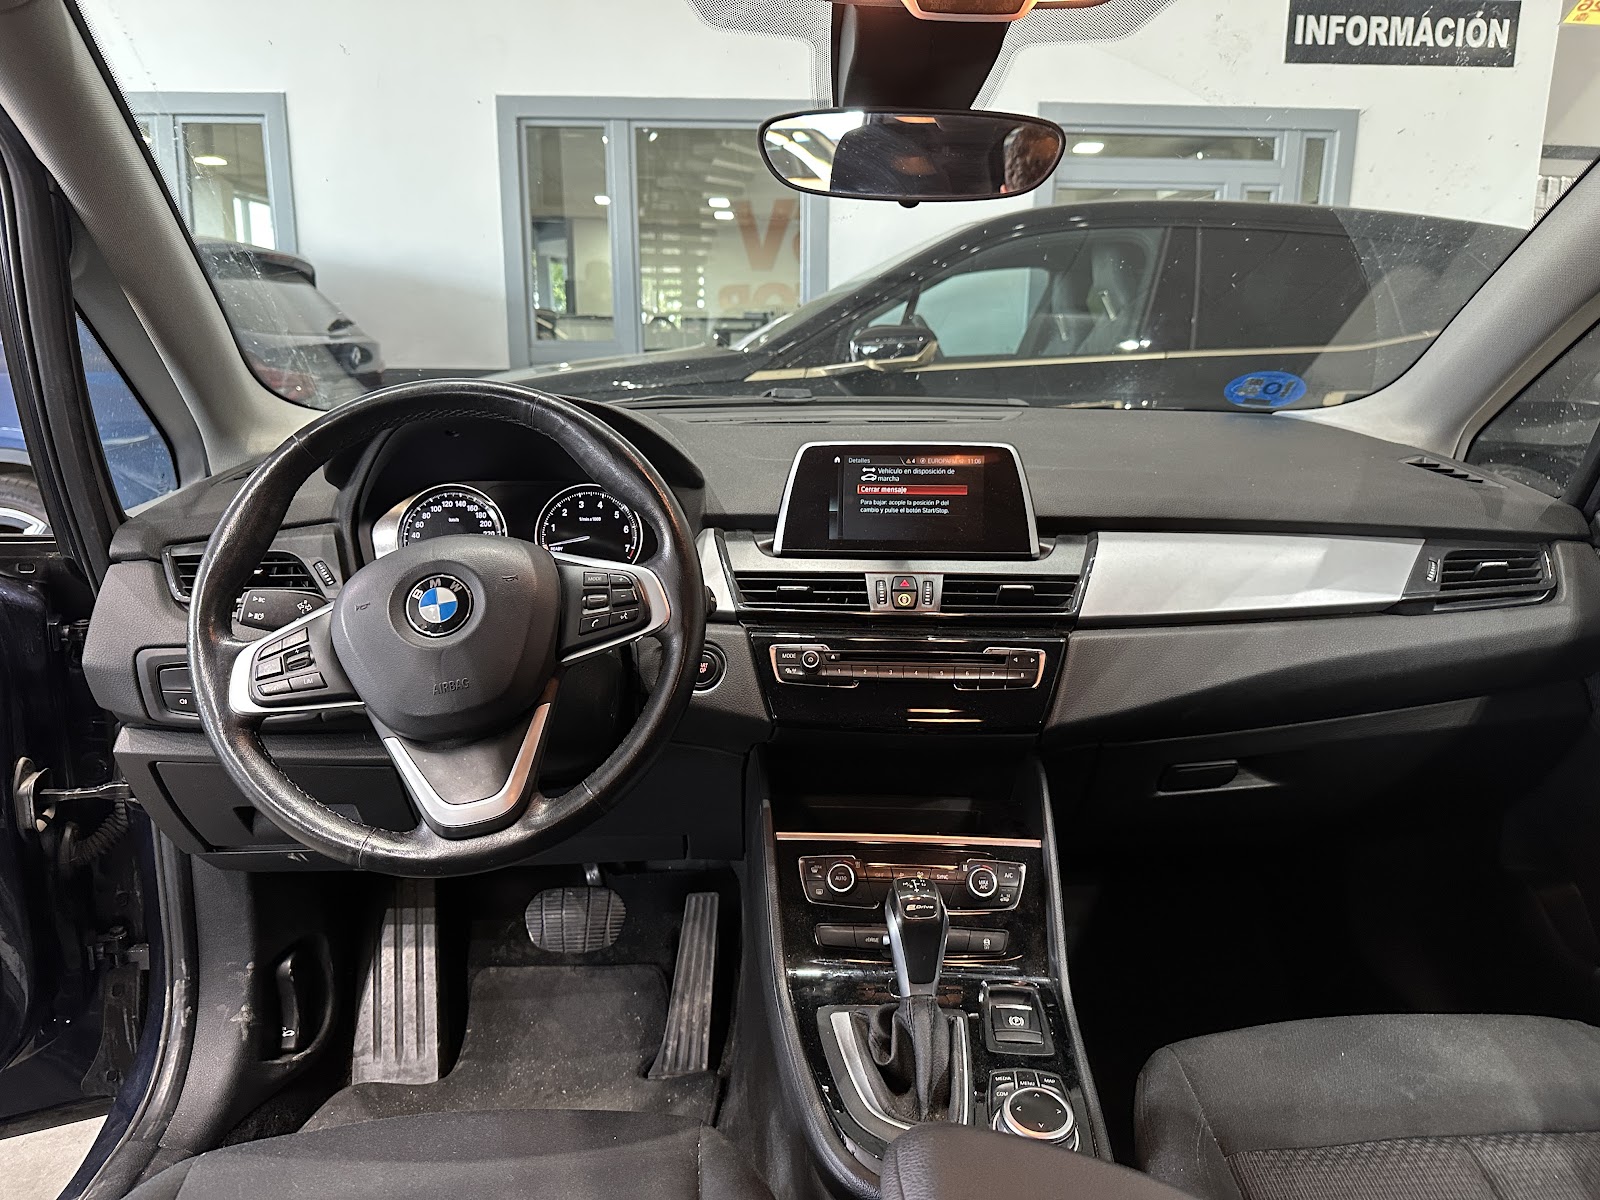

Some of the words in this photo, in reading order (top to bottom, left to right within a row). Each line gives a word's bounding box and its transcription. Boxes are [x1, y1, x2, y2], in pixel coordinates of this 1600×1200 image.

[1294, 10, 1511, 48] INFORMACIÓN
[597, 501, 603, 509] 4
[551, 524, 555, 532] 1
[625, 544, 630, 552] 7
[412, 578, 462, 600] BMW
[432, 677, 470, 696] AIRBAG
